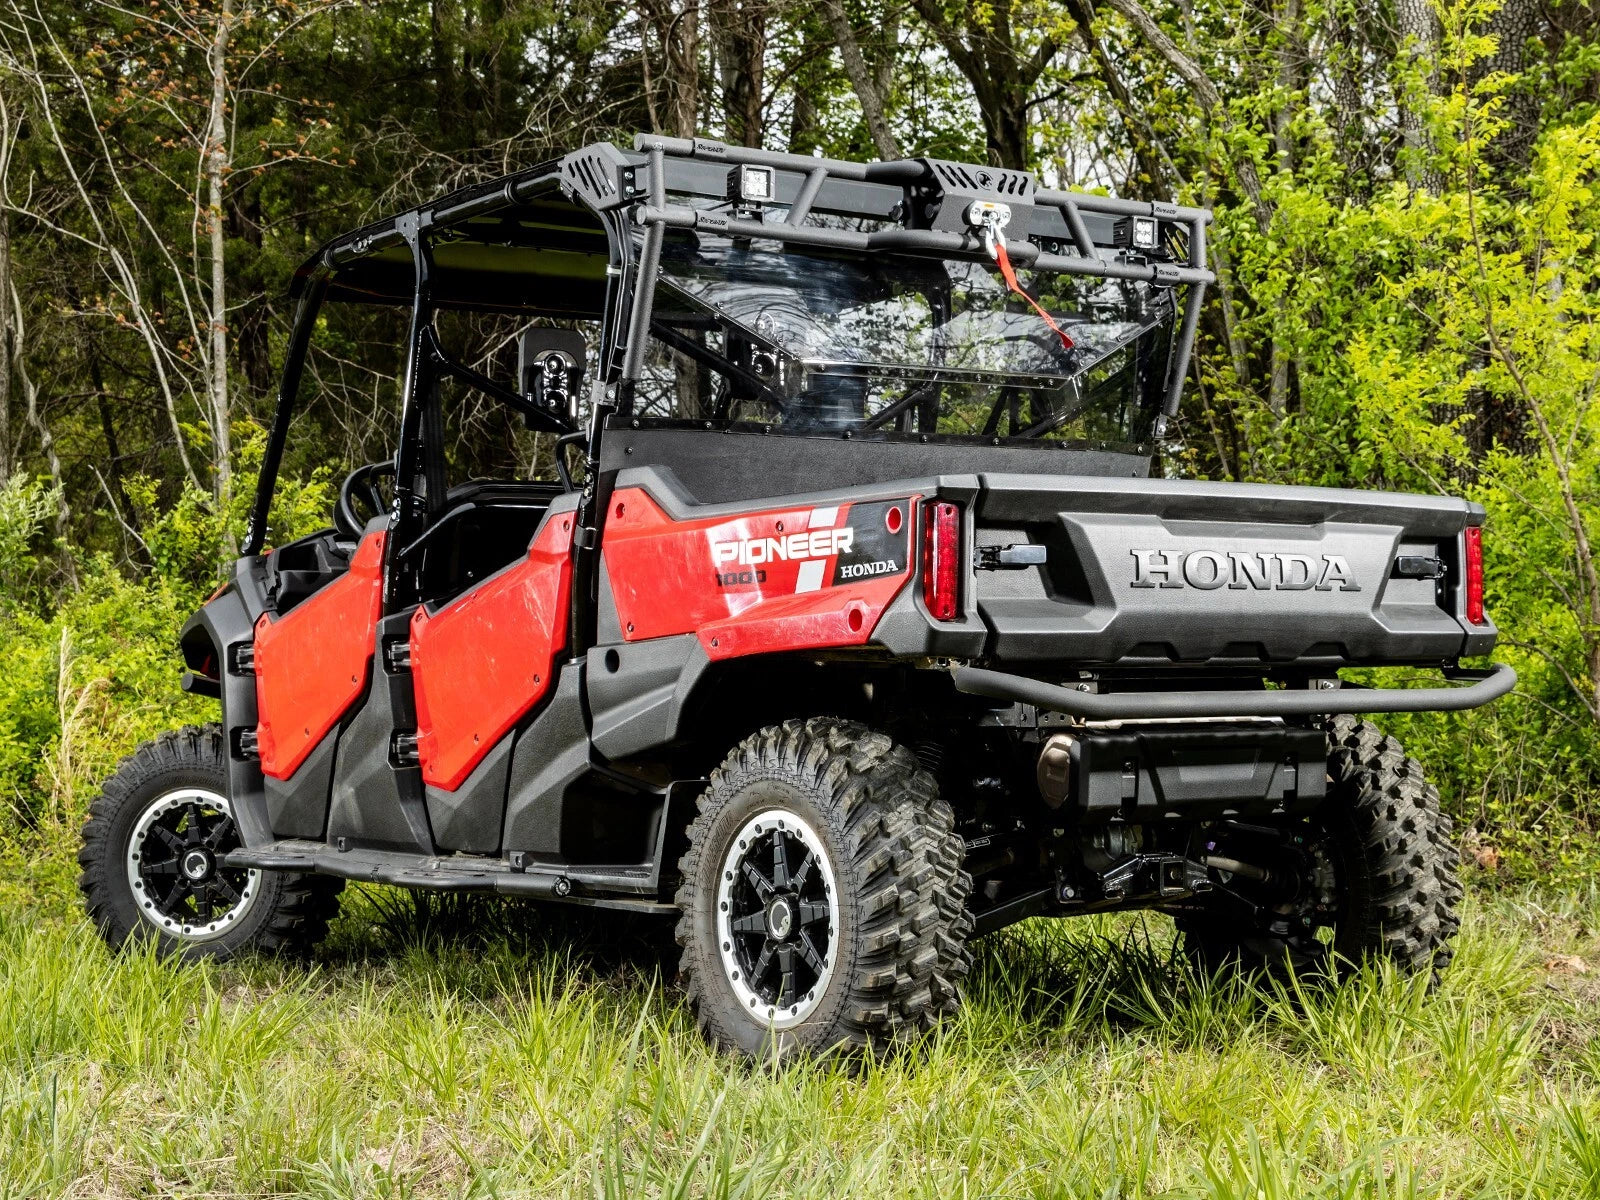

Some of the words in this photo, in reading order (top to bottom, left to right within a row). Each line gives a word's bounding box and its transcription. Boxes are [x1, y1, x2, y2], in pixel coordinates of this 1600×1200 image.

[714, 527, 854, 568] PIONEER
[715, 569, 767, 587] 1000
[840, 559, 899, 579] HONDA
[1130, 549, 1362, 592] HONDA
